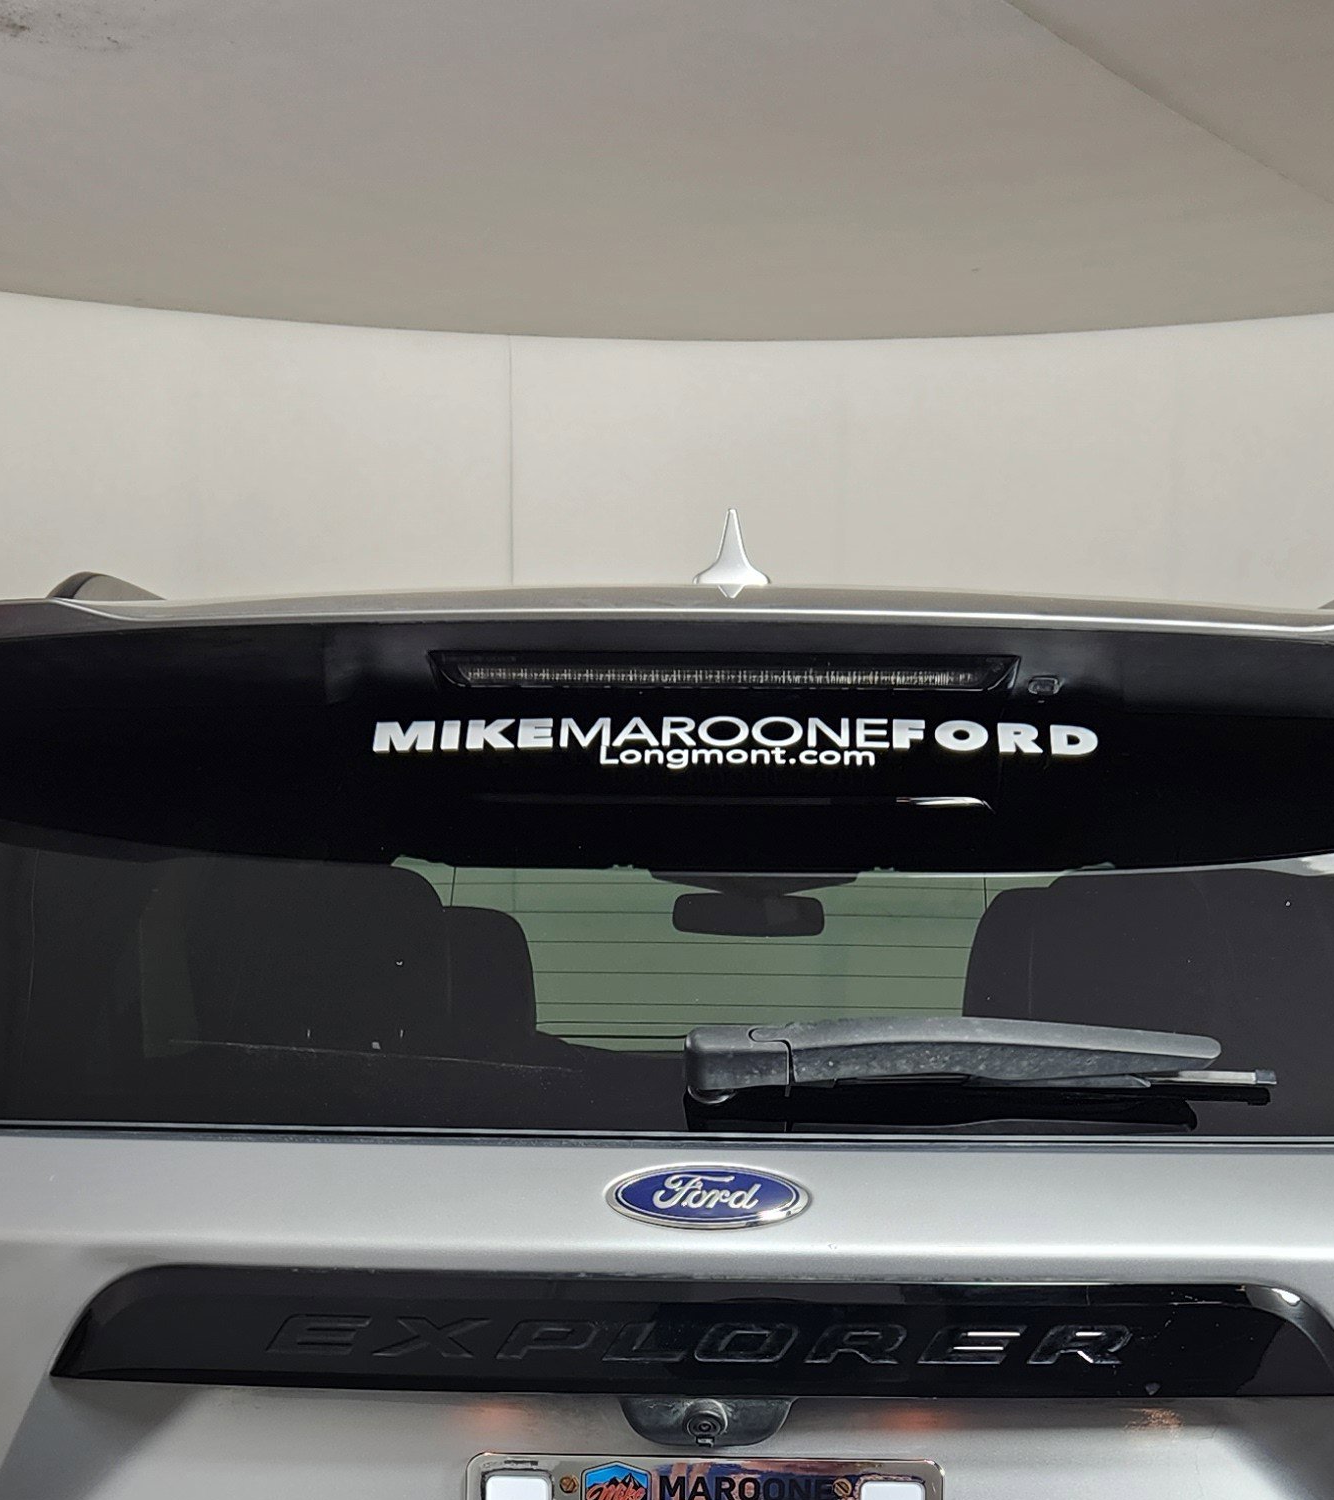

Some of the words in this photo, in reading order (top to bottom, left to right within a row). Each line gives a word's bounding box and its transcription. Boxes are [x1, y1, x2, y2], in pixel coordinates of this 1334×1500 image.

[600, 744, 875, 769] Longmont.com
[653, 1174, 762, 1210] Ford
[264, 1313, 1132, 1368] EXPLORER
